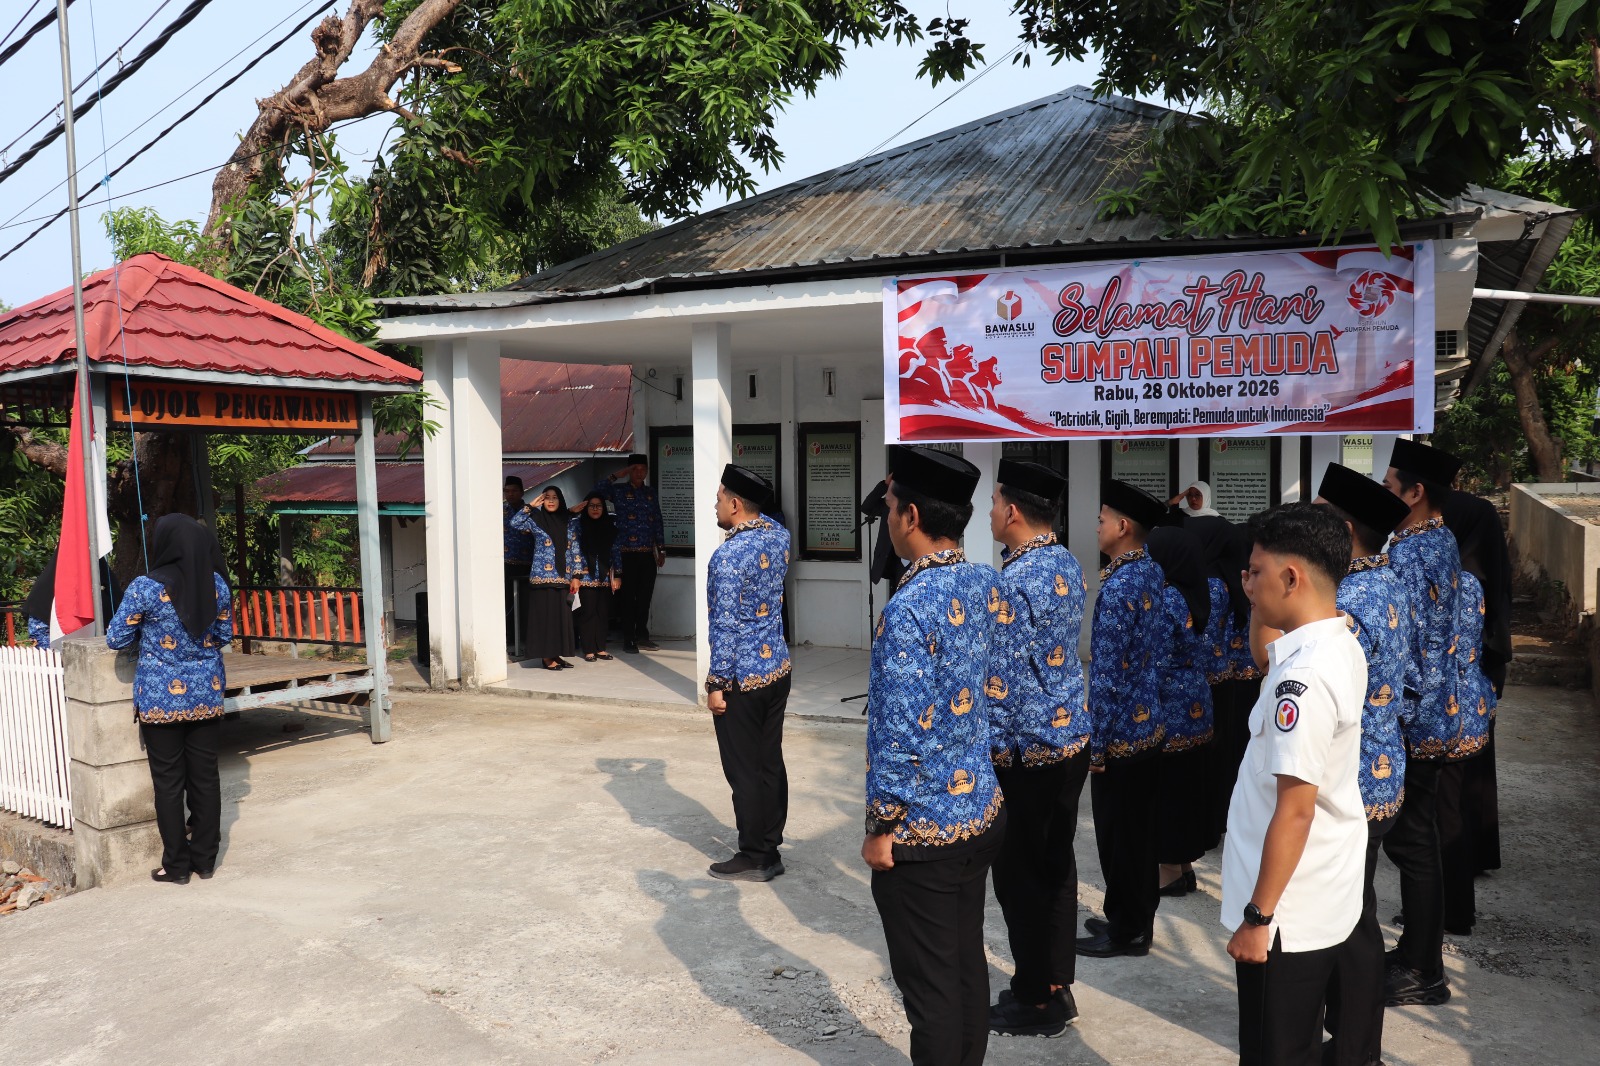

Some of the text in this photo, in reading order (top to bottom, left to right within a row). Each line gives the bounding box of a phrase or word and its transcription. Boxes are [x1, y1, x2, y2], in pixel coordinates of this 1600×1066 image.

[1053, 269, 1325, 338] Selamat Hari
[985, 322, 1035, 334] BAWASLU
[1372, 324, 1399, 332] PEMUDA
[1041, 330, 1339, 384] SUMPAH PEMUDA
[1094, 379, 1280, 403] Rabu, 28 Oktober 2026
[121, 387, 351, 424] POJOK PENGAWASAN
[1049, 403, 1331, 430] “Patriotik, Gigih, Berempati: Pemuda untuk Indonesia”
[1227, 439, 1266, 447] BAWASLU
[1343, 438, 1373, 446] WASLU
